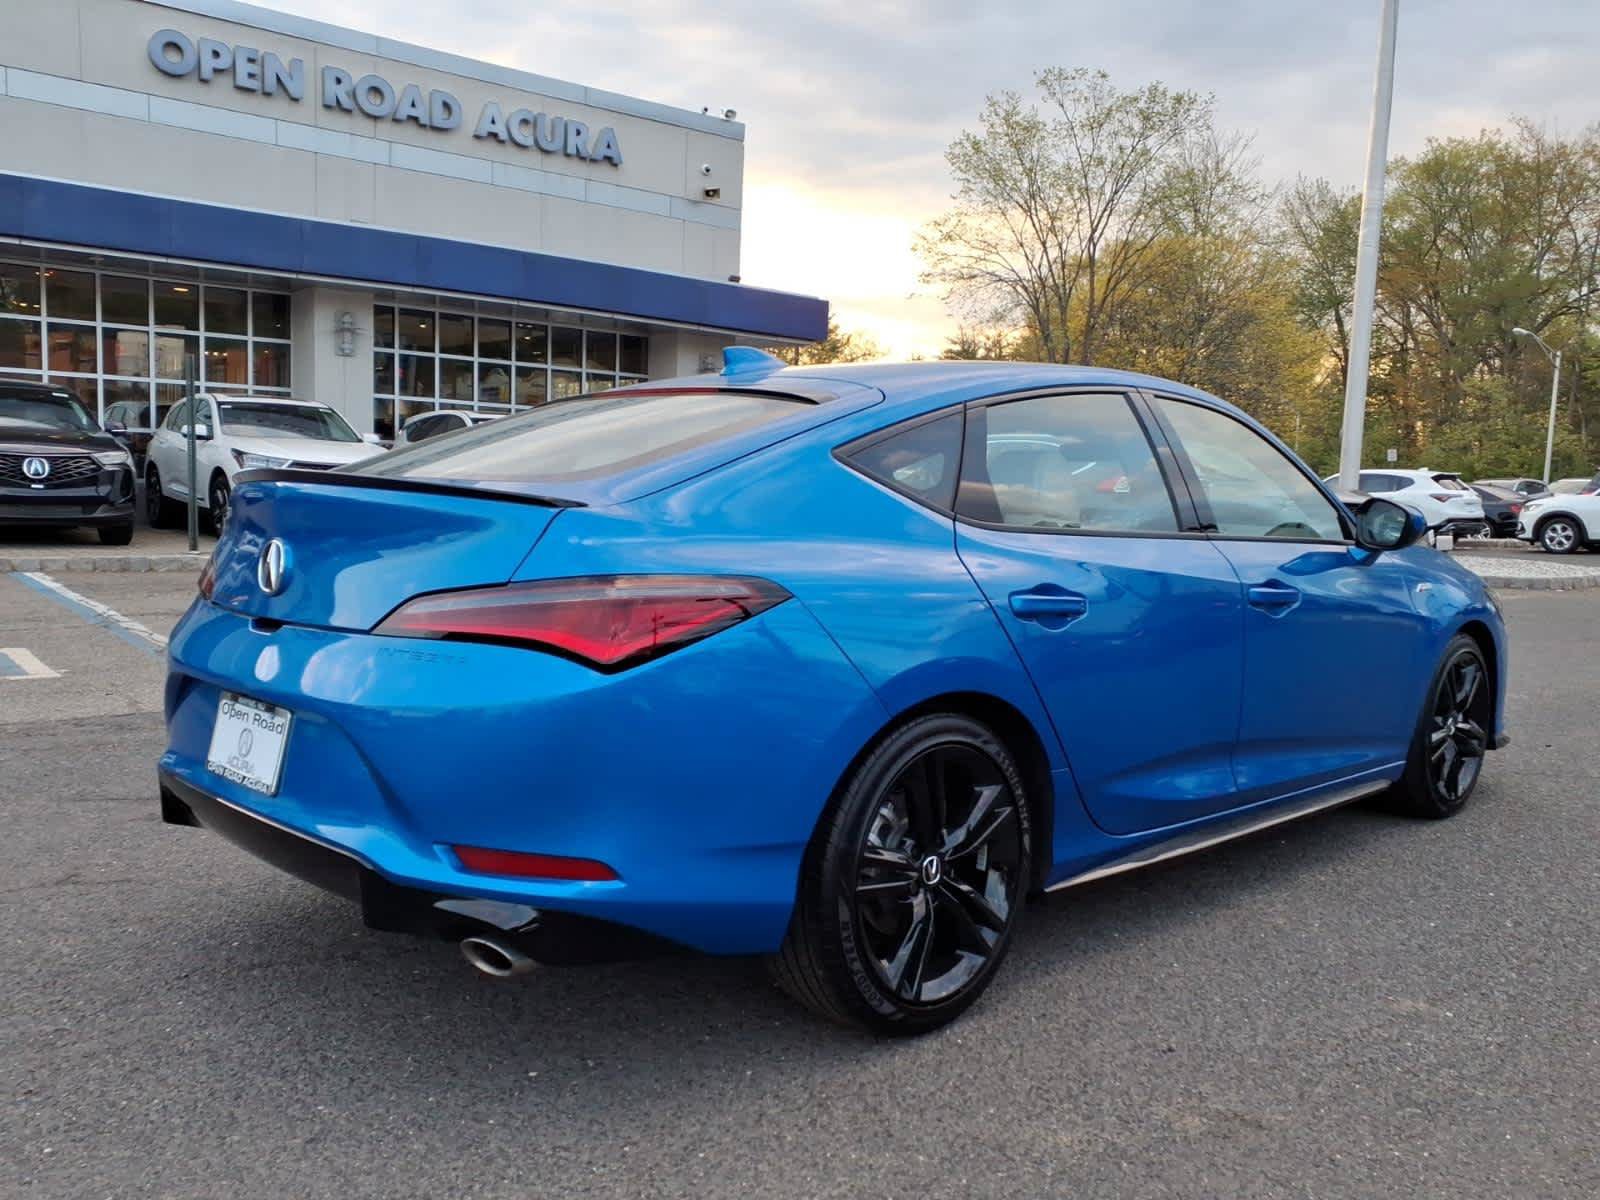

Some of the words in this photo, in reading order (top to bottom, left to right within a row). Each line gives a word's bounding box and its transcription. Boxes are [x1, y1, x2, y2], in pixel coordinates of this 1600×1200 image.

[147, 28, 304, 100] OPEN
[321, 65, 463, 131] ROAD
[473, 100, 624, 166] ACURA
[222, 702, 250, 722] Open
[252, 713, 285, 735] Road
